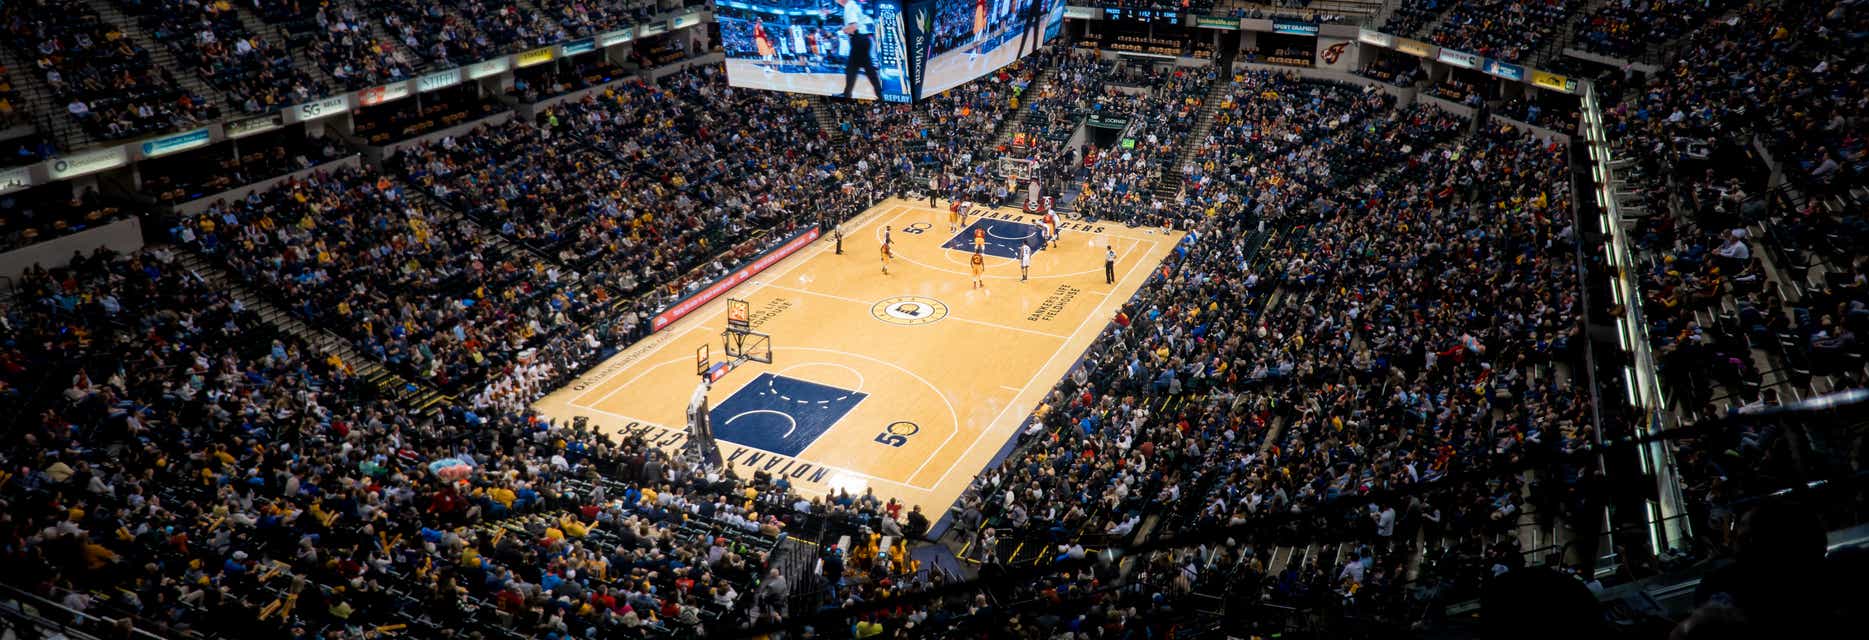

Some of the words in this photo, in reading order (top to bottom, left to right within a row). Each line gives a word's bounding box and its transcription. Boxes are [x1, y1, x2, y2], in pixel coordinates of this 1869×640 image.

[883, 94, 910, 103] REPLAY
[969, 208, 1024, 222] DIANA
[1059, 221, 1106, 233] CERS
[1027, 295, 1058, 322] BANKERS
[1055, 284, 1071, 296] LIFE
[1041, 287, 1081, 322] FIELDHOUSE
[616, 421, 684, 447] CERS
[873, 421, 920, 448] 50
[726, 446, 831, 484] NDIANA
